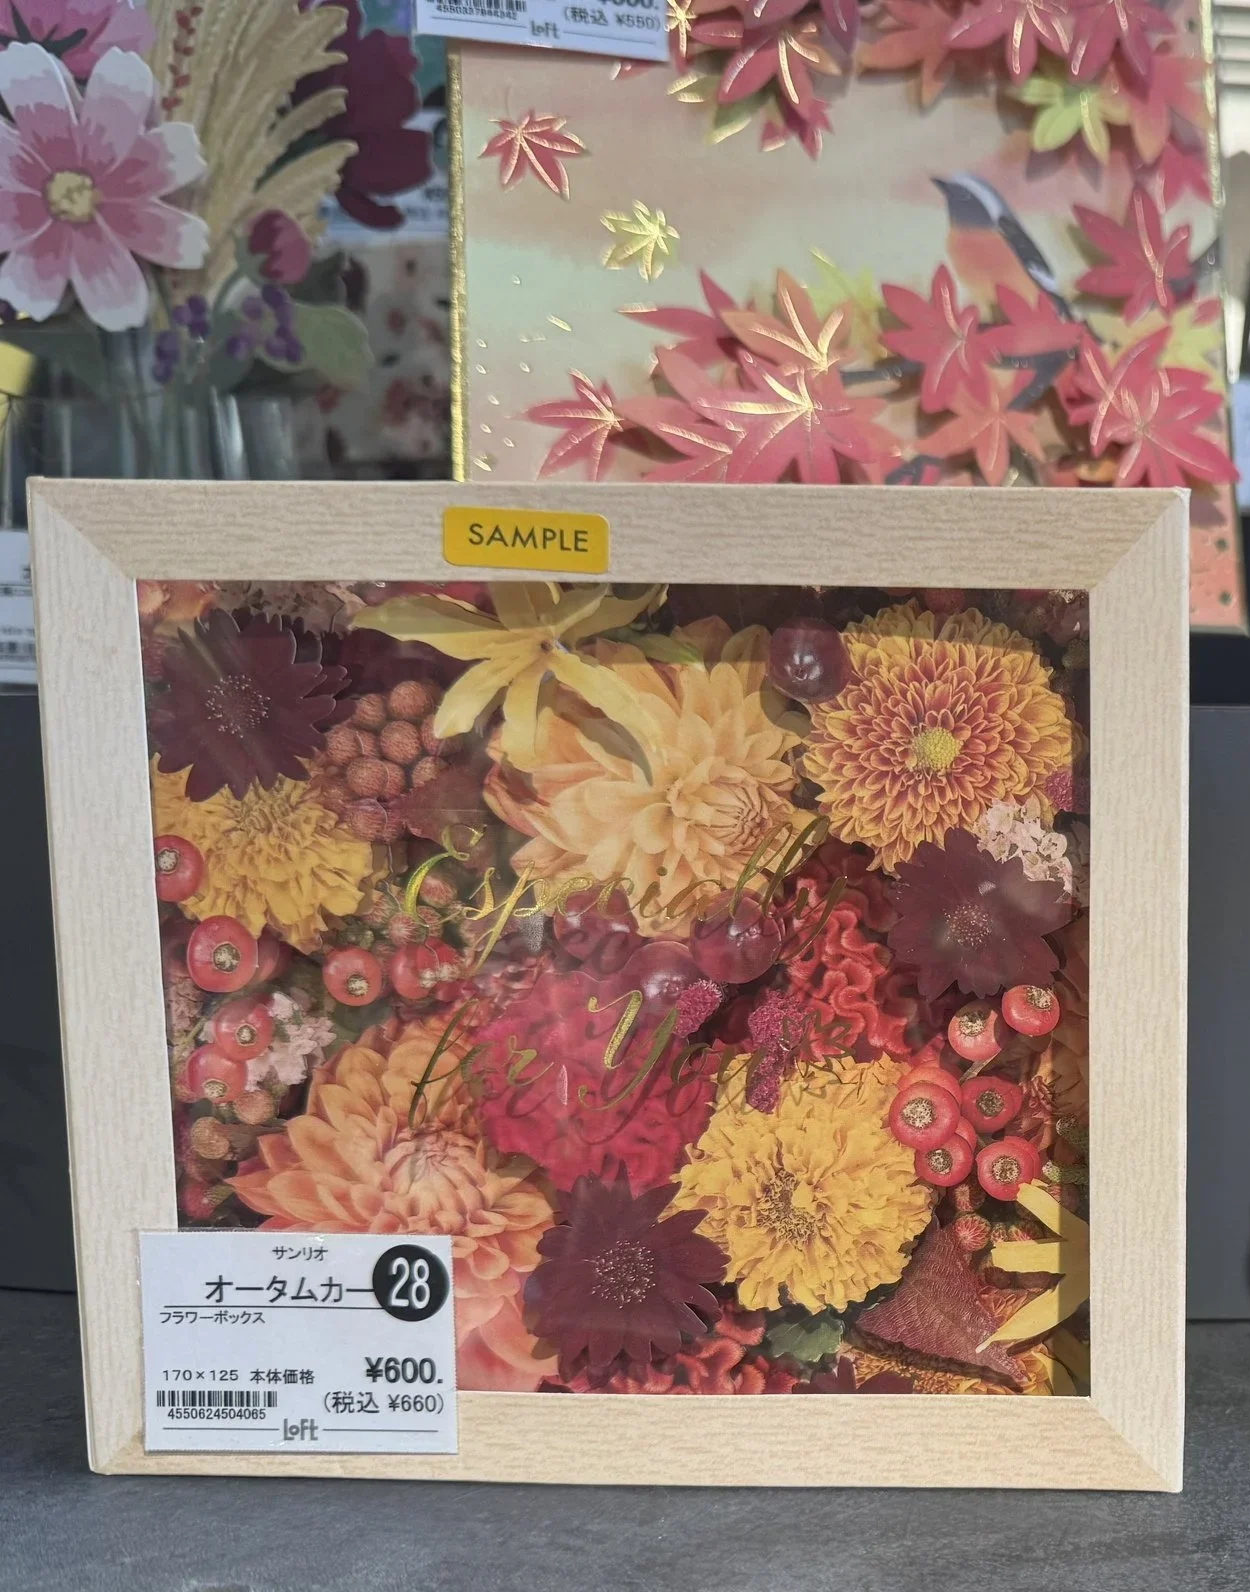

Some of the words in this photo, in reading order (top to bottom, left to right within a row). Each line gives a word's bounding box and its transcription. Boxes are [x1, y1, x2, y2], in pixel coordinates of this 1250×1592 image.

[468, 523, 589, 552] SAMPLE
[272, 1246, 329, 1262] サンリオ
[388, 1257, 431, 1310] 28
[160, 1311, 266, 1325] フラワーボックス
[249, 1369, 315, 1384] 本体価格
[365, 1356, 443, 1384] ¥600.
[167, 1408, 266, 1420] 4550624504065
[323, 1391, 379, 1414] (税込
[388, 1393, 445, 1414] ¥660)
